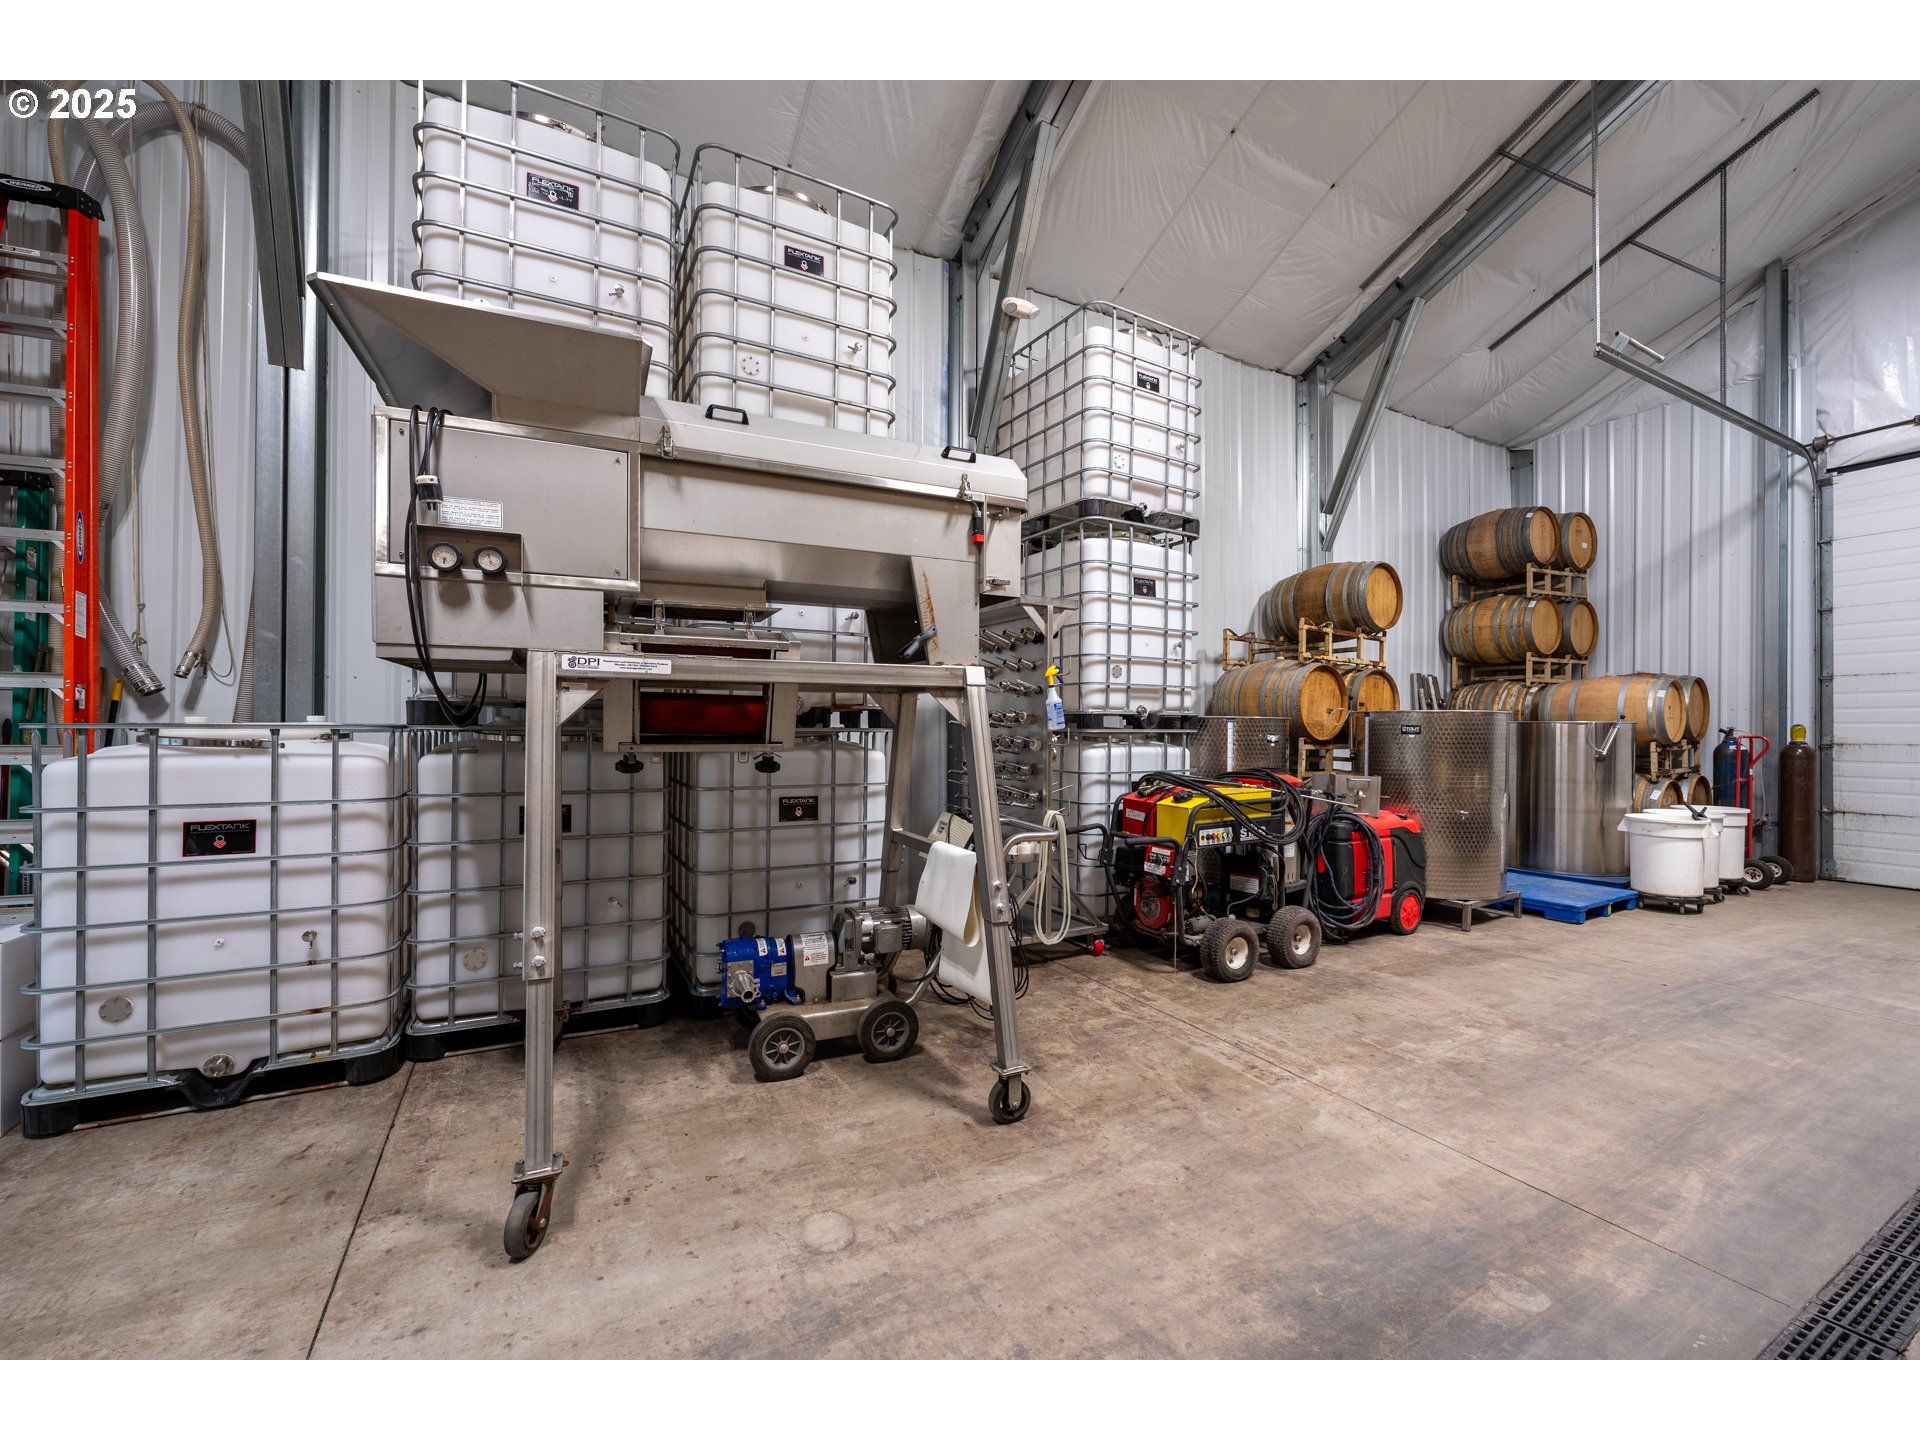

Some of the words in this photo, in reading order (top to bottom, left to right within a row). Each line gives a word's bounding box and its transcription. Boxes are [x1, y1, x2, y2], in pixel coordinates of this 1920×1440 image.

[9, 180, 41, 189] WERNER
[577, 657, 600, 666] DPI
[190, 823, 251, 832] FLEXTANK
